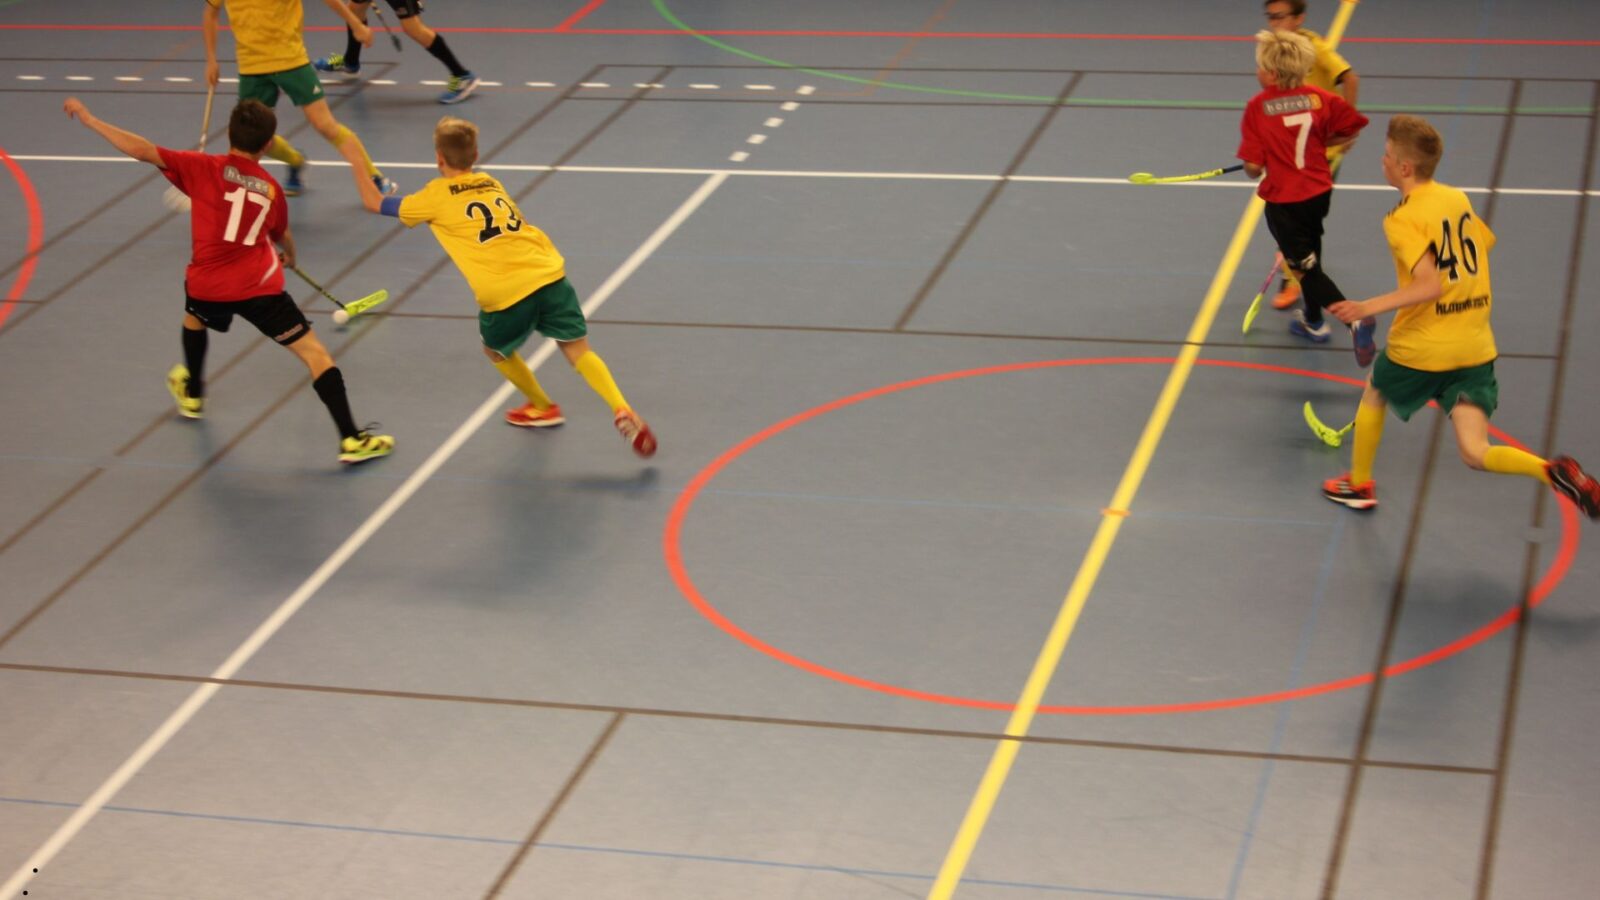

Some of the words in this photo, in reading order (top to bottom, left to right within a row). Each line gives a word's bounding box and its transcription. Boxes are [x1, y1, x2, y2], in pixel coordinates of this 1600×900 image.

[1282, 111, 1313, 170] 7
[223, 187, 272, 246] 17
[465, 197, 522, 244] 23
[1437, 211, 1478, 281] 46
